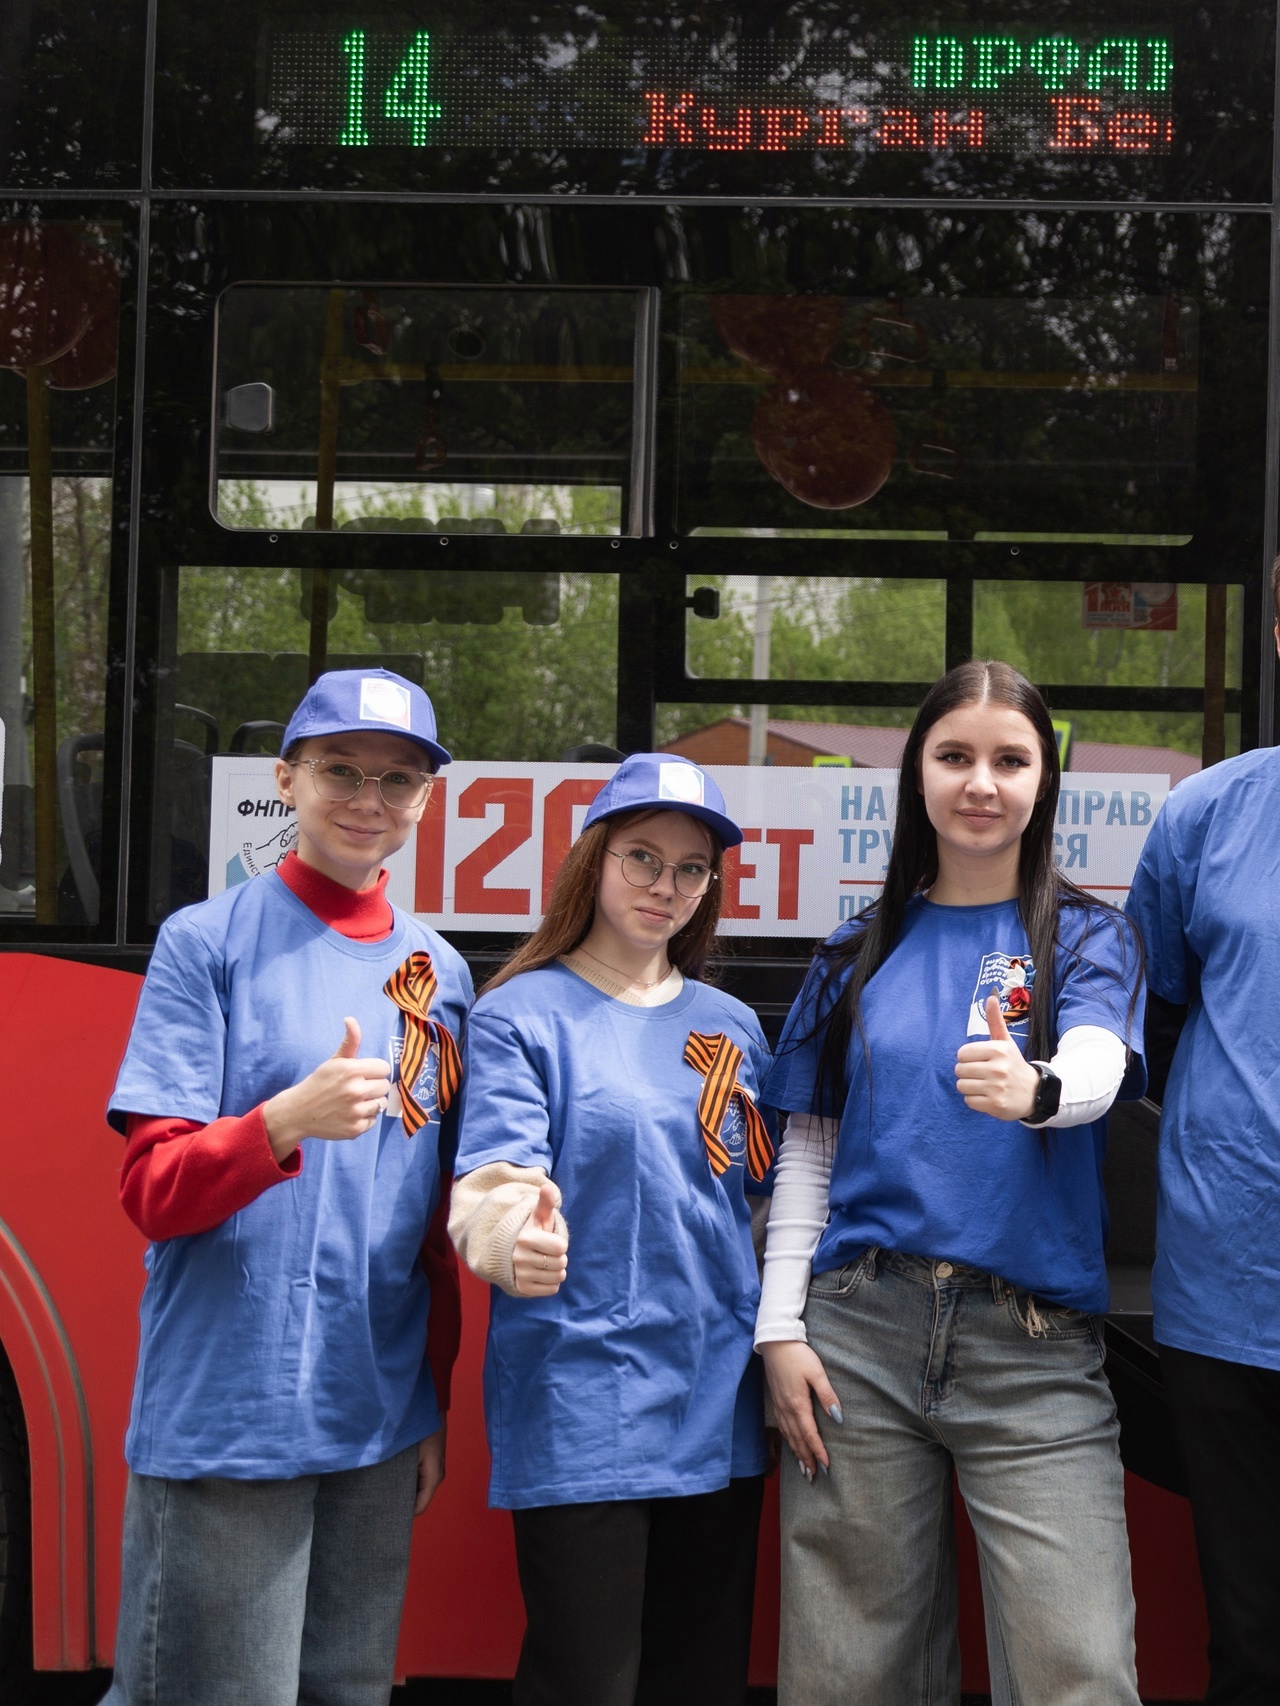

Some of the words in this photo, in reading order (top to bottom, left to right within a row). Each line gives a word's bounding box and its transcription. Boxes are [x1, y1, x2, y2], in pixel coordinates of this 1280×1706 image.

[341, 30, 442, 147] 14
[644, 92, 984, 150] Курган
[1050, 97, 1174, 149] Бе
[840, 785, 887, 821] НА
[1058, 790, 1152, 826] ПРАВ
[718, 828, 814, 920] ЕТ
